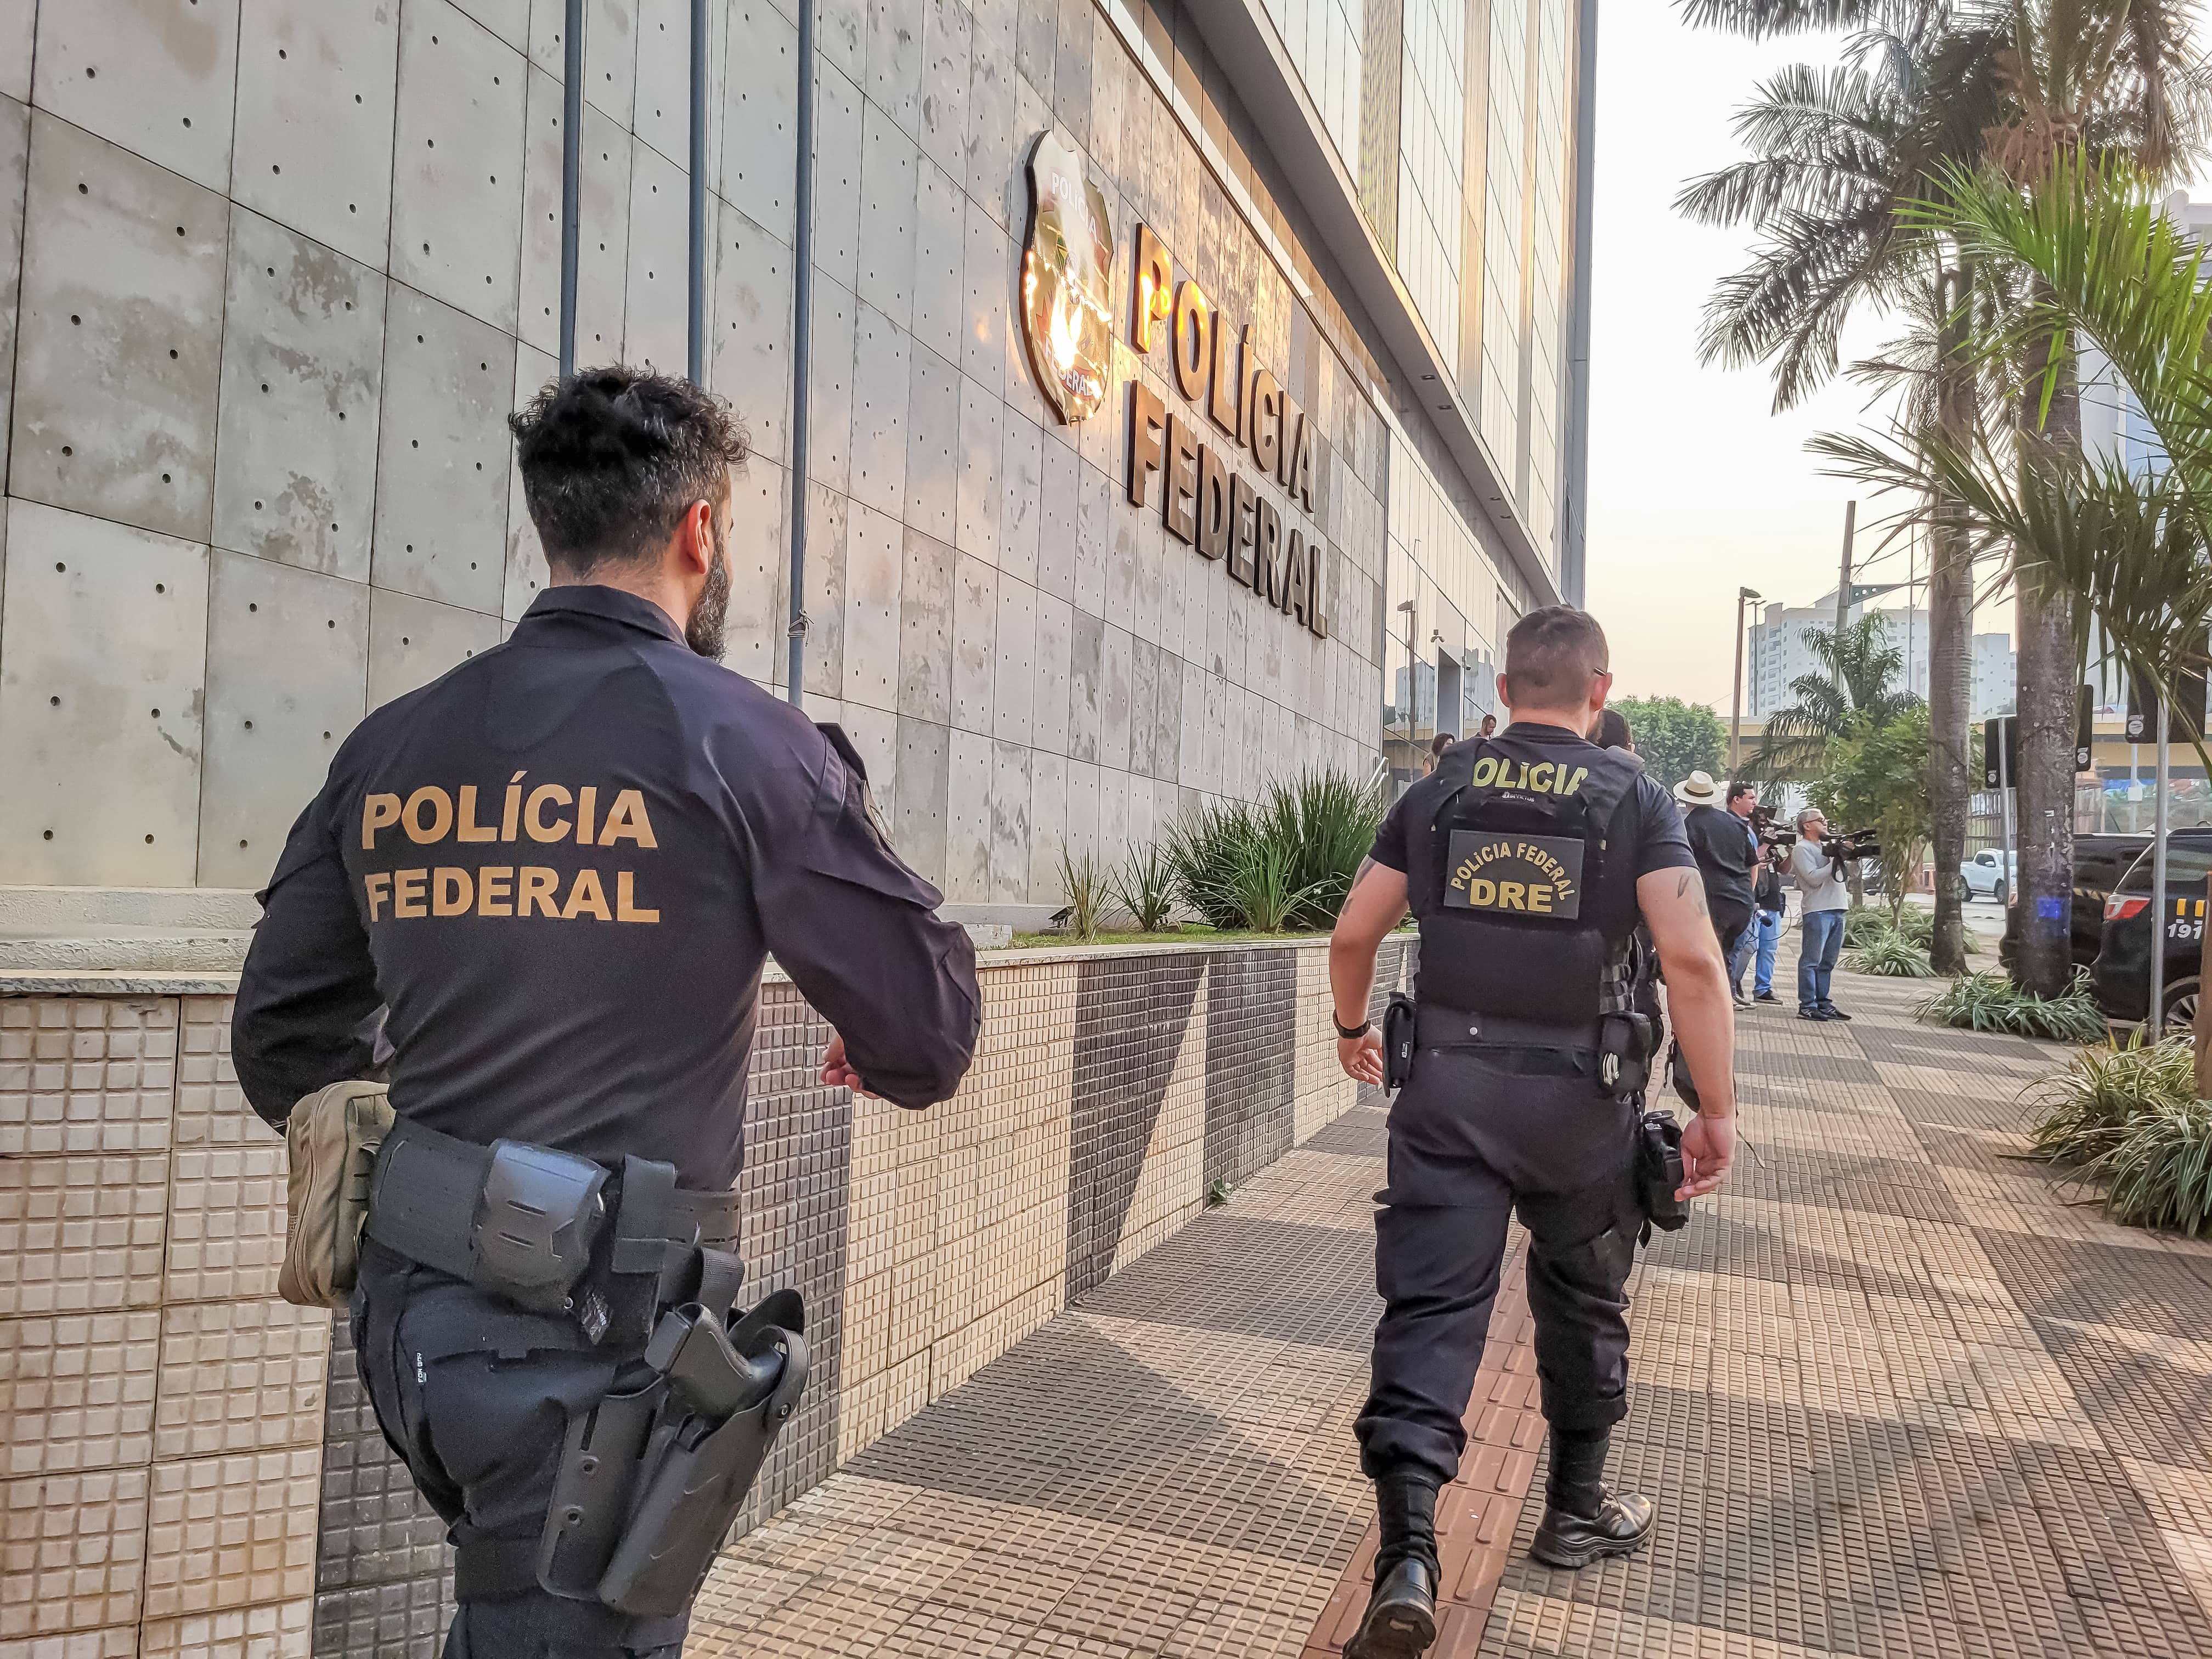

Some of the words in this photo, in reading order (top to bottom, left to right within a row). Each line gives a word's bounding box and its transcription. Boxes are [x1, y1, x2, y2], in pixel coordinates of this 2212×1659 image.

[1131, 222, 1316, 513] POLÍCIA
[1127, 380, 1328, 639] FEDERAL
[1472, 757, 1588, 795] OLÍCIA
[362, 770, 658, 849] POLÍCIA
[365, 866, 659, 923] FEDERAL
[1451, 842, 1511, 890] POLÍCIA
[1517, 843, 1575, 900] FEDERAL
[1470, 878, 1553, 913] DRE
[2168, 923, 2203, 939] 191
